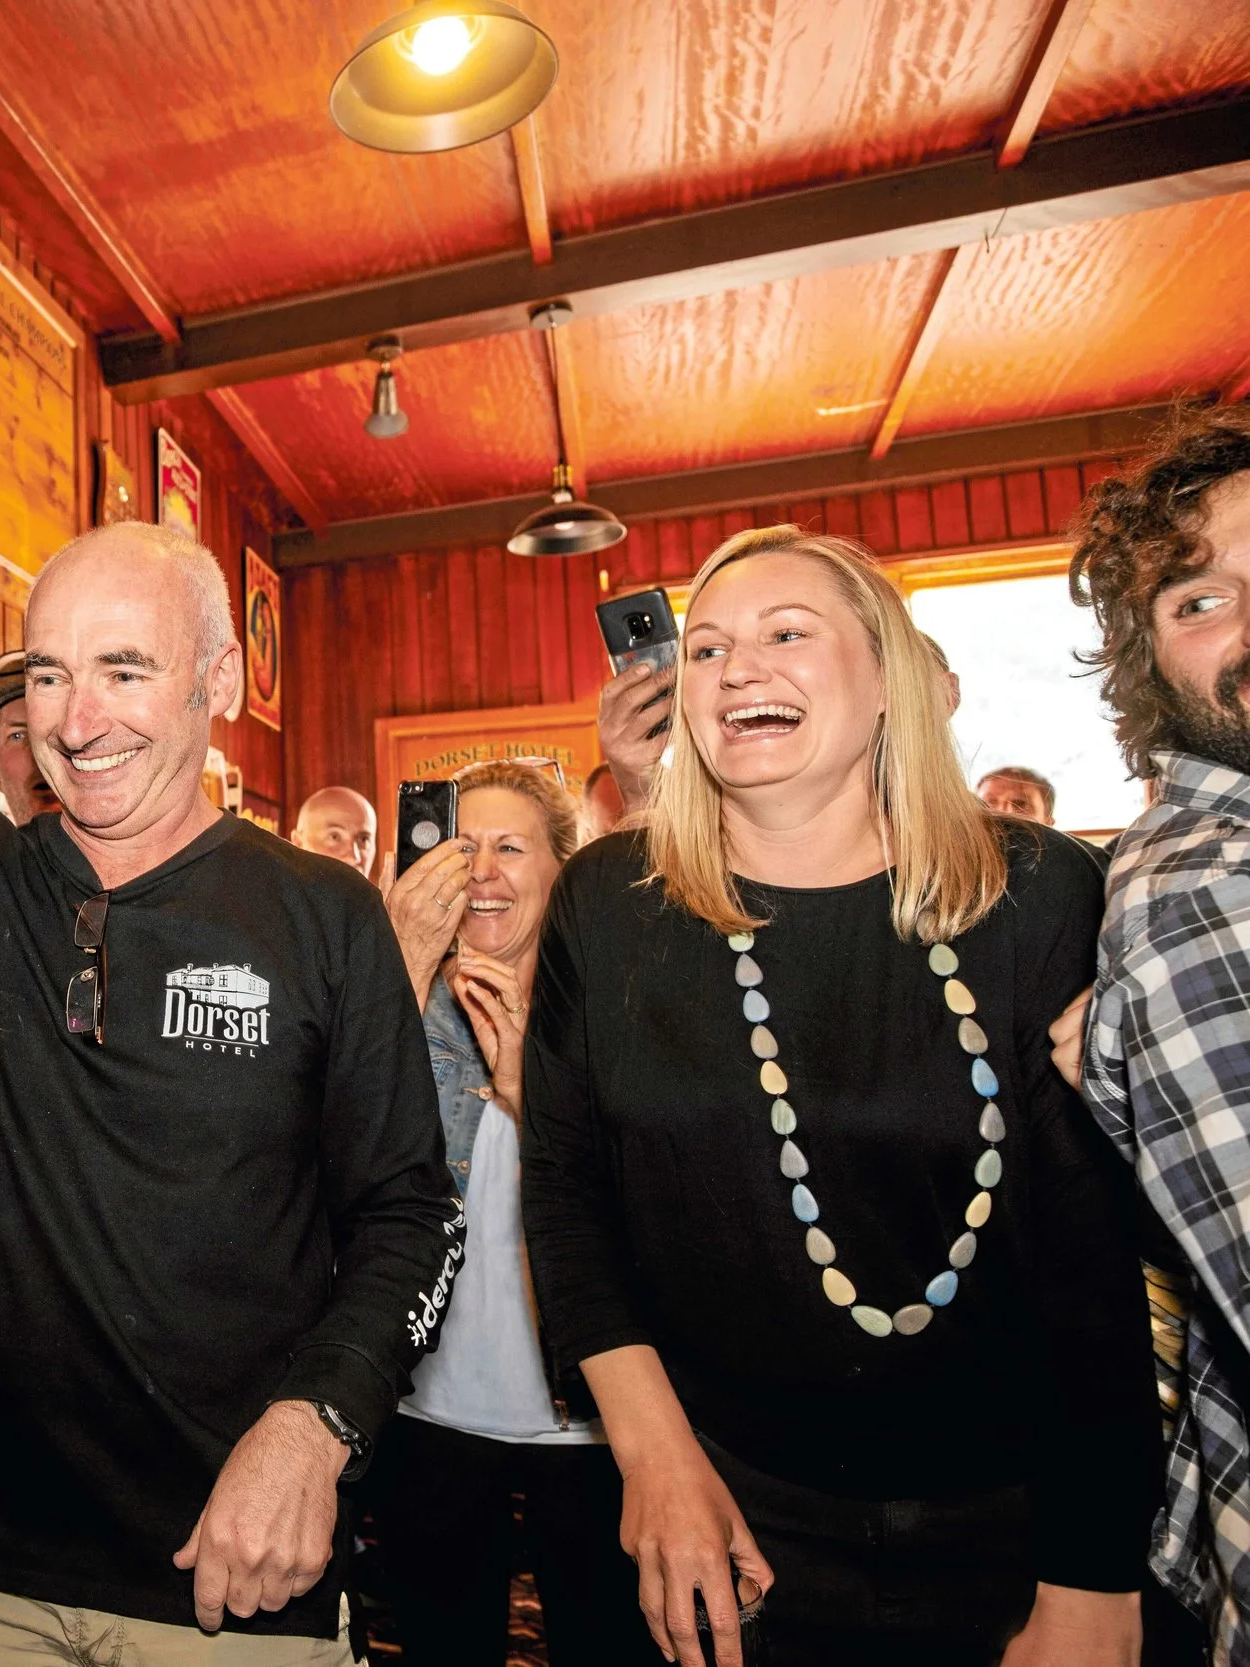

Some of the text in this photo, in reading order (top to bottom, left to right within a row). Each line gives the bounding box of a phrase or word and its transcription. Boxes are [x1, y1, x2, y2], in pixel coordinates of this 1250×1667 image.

[414, 743, 576, 776] DORSET HOTEL
[160, 987, 271, 1046] Dorset
[185, 1040, 256, 1058] HOTEL
